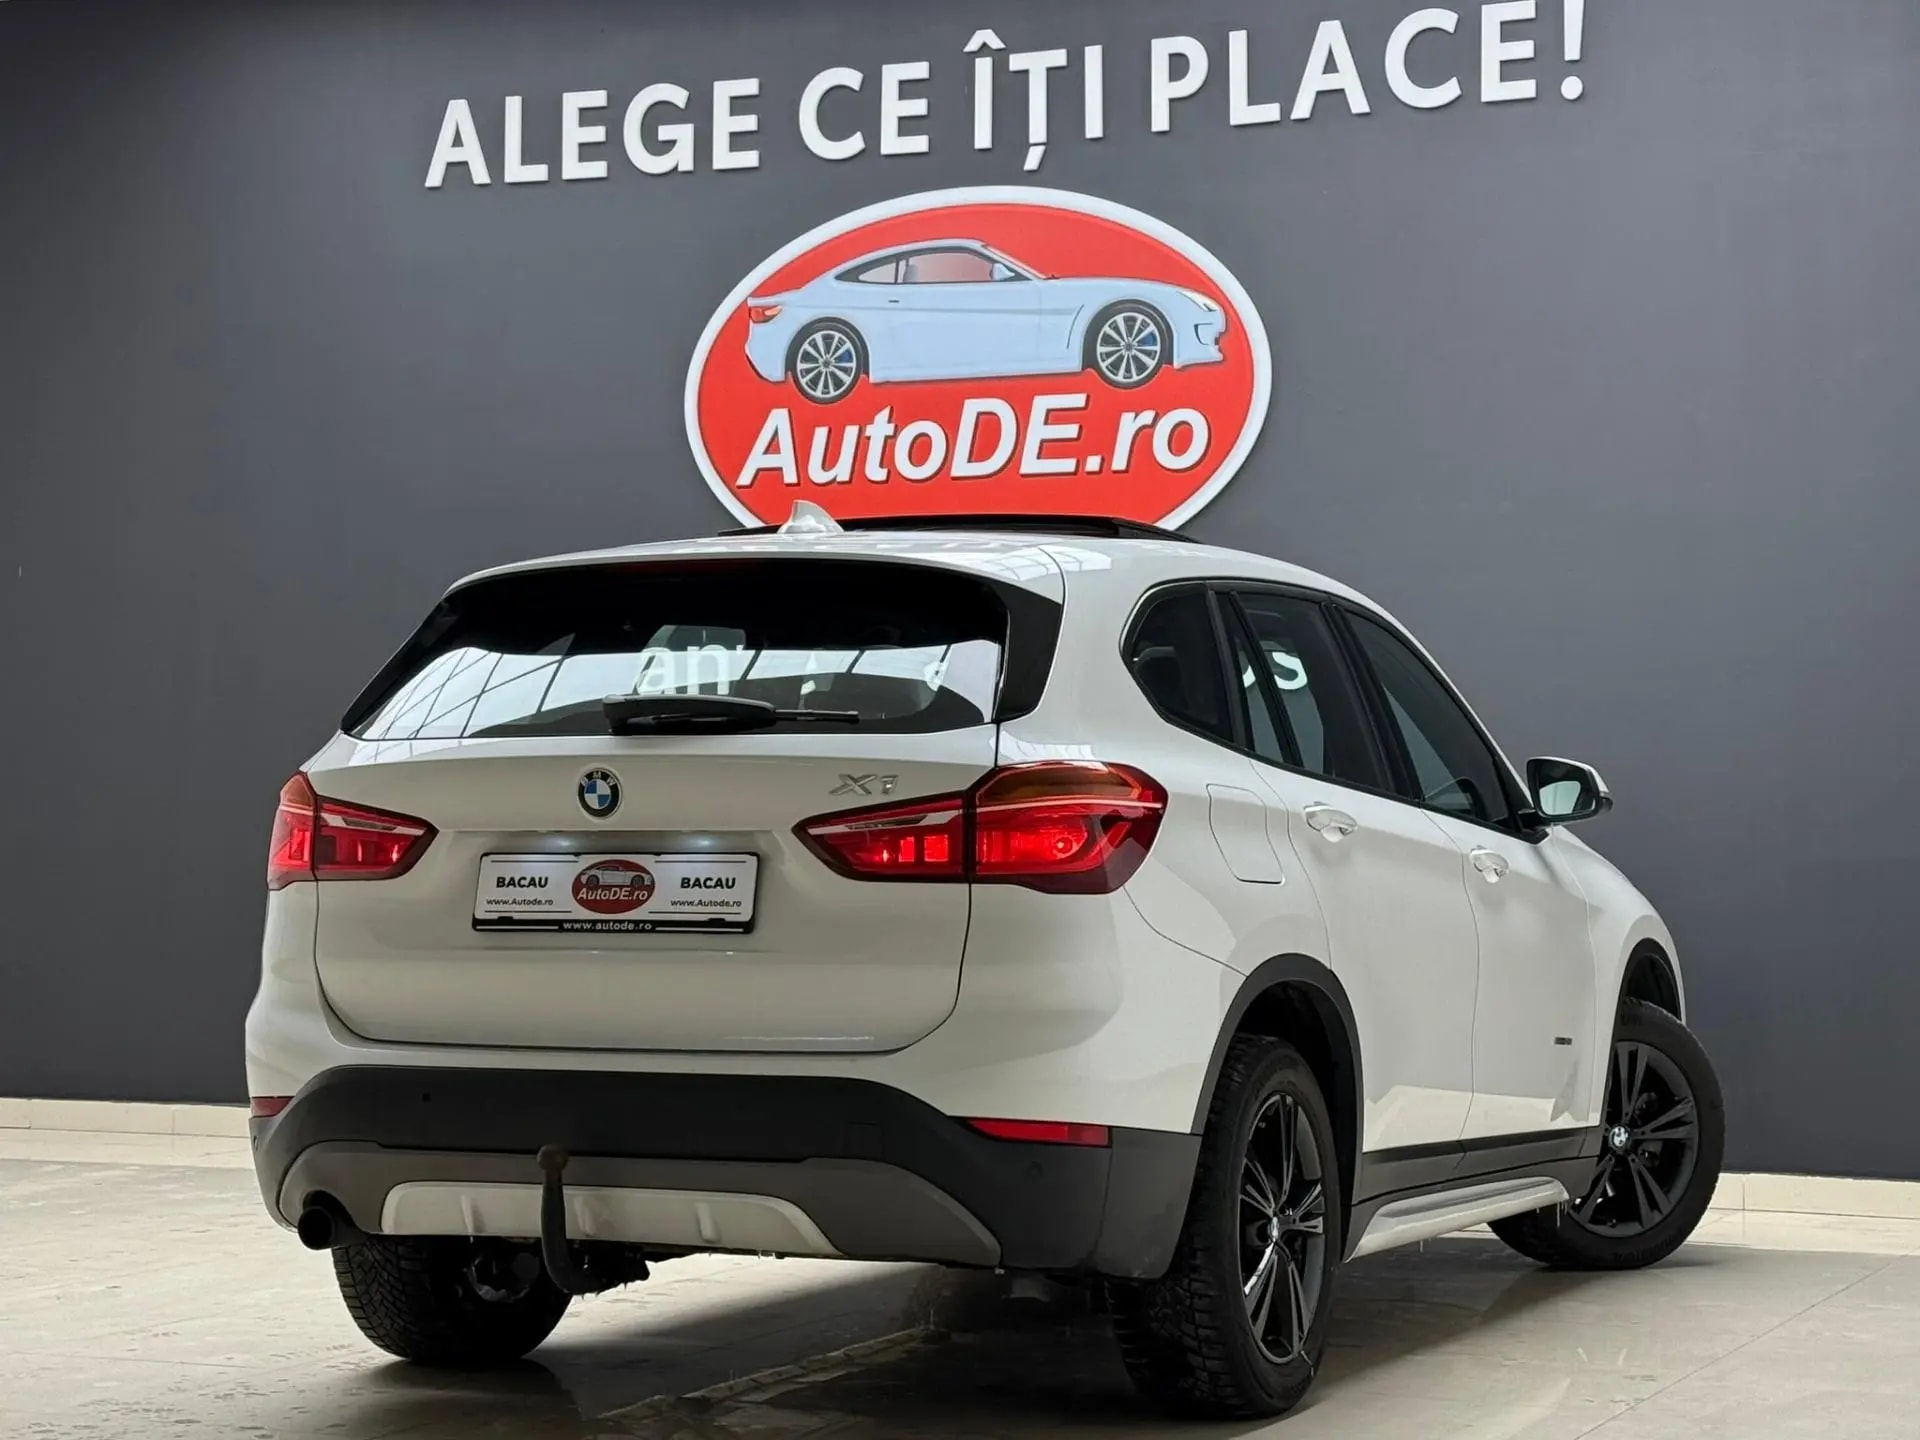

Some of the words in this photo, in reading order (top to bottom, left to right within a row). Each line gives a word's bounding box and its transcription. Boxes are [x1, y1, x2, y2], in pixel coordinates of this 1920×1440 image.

[424, 78, 760, 188] ALEGE
[798, 61, 930, 160] CE
[1150, 0, 1584, 133] PLACE!
[736, 393, 1209, 487] AutoDE.ro
[828, 774, 899, 796] X1
[496, 876, 549, 889] BACAU
[680, 877, 736, 890] BACAU
[577, 887, 649, 901] AutoDE.ro
[562, 921, 653, 931] www.autode.ro
